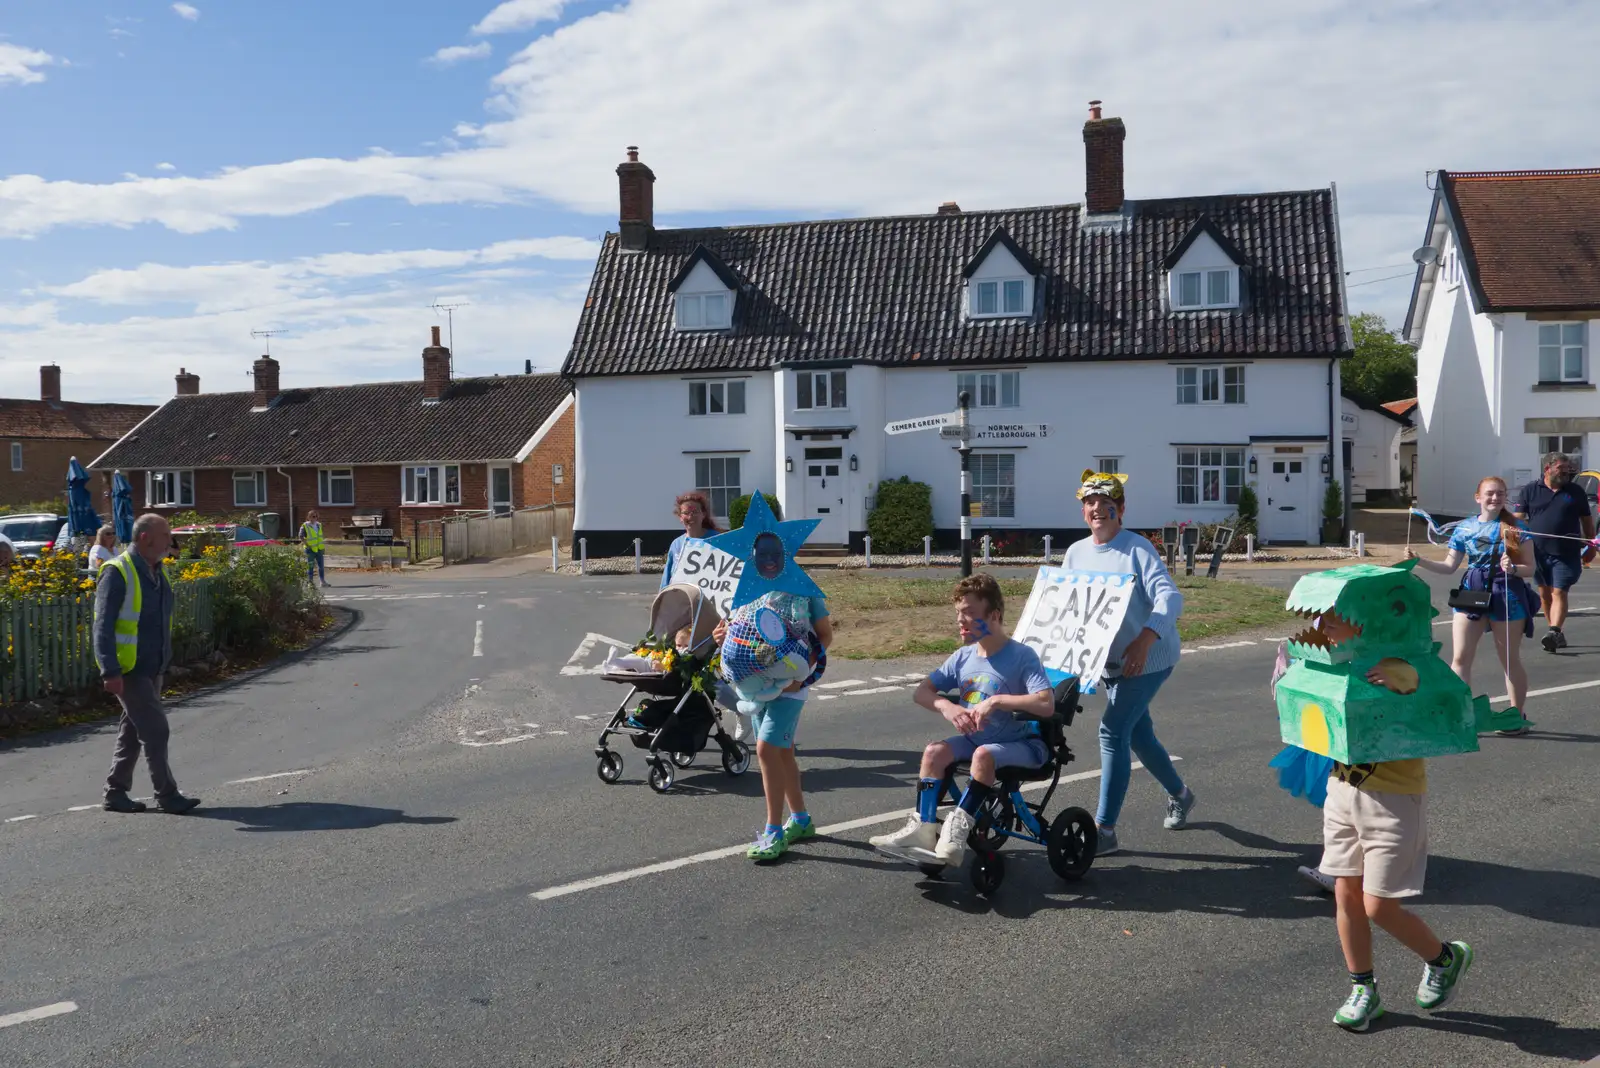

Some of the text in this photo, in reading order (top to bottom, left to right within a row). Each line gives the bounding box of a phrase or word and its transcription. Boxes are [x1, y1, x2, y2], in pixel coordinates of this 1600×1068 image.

[891, 422, 917, 432] SEMERE
[917, 418, 940, 428] GREEN
[683, 550, 745, 579] SAVE
[698, 577, 731, 593] OUR
[1034, 585, 1121, 630] SAVE
[1050, 626, 1086, 645] OUR
